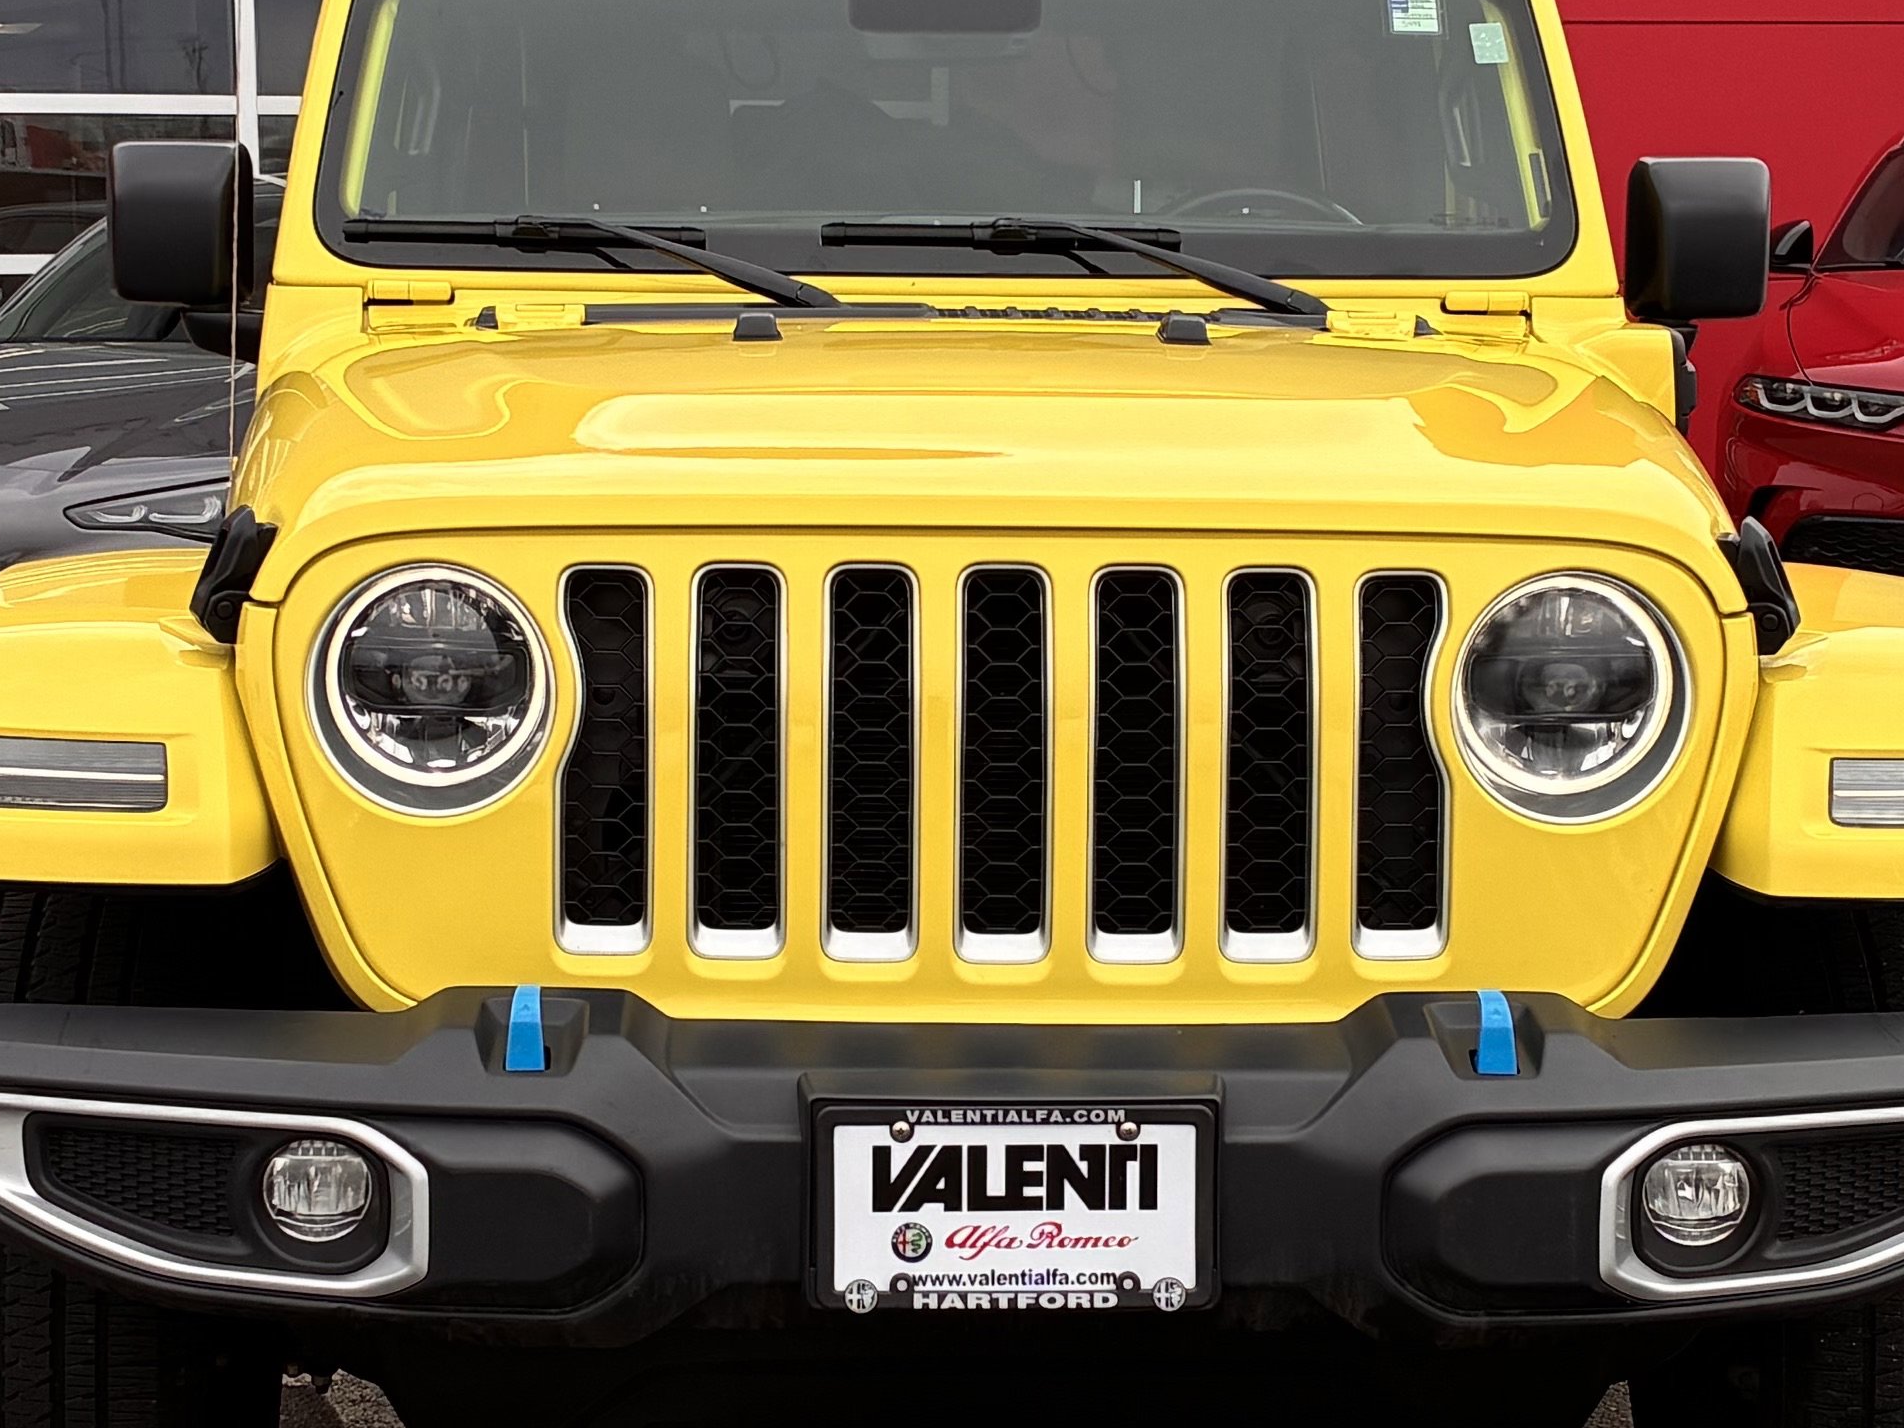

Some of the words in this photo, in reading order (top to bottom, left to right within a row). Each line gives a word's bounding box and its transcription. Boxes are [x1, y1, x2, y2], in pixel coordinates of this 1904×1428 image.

[906, 1109, 1126, 1123] VALENTIALFA.COM
[872, 1144, 1158, 1212] VALENTI
[945, 1225, 1023, 1261] Alfa
[1026, 1221, 1139, 1249] Romeo
[913, 1269, 1117, 1287] www.valentialfa.com
[913, 1292, 1118, 1310] HARTFORD
